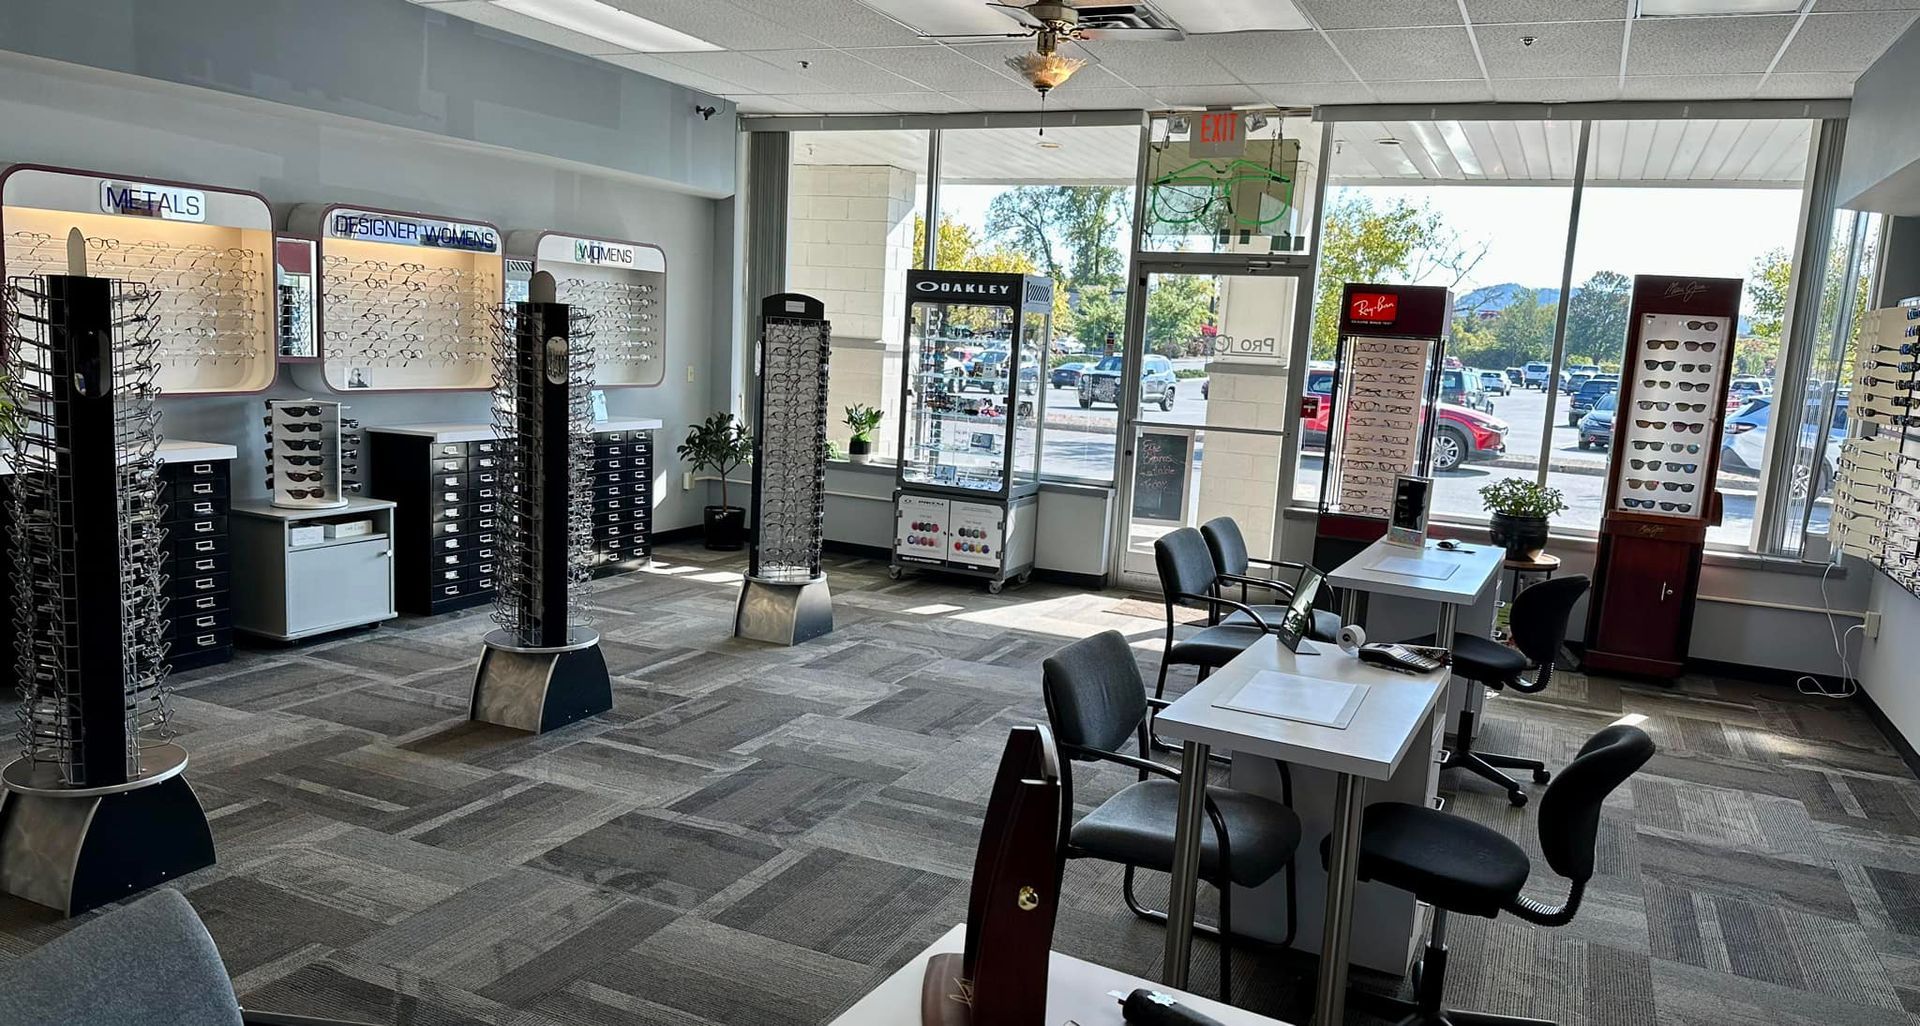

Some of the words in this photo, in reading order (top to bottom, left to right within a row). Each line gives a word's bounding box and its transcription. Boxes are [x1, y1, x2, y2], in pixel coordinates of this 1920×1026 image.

[1200, 112, 1238, 143] EXIT
[106, 186, 200, 216] METALS
[335, 215, 418, 240] DESIGNER
[424, 225, 494, 249] WOMENS
[578, 243, 633, 264] WOMENS
[940, 282, 1010, 295] OAKLEY
[1353, 295, 1395, 317] Ray-Ban
